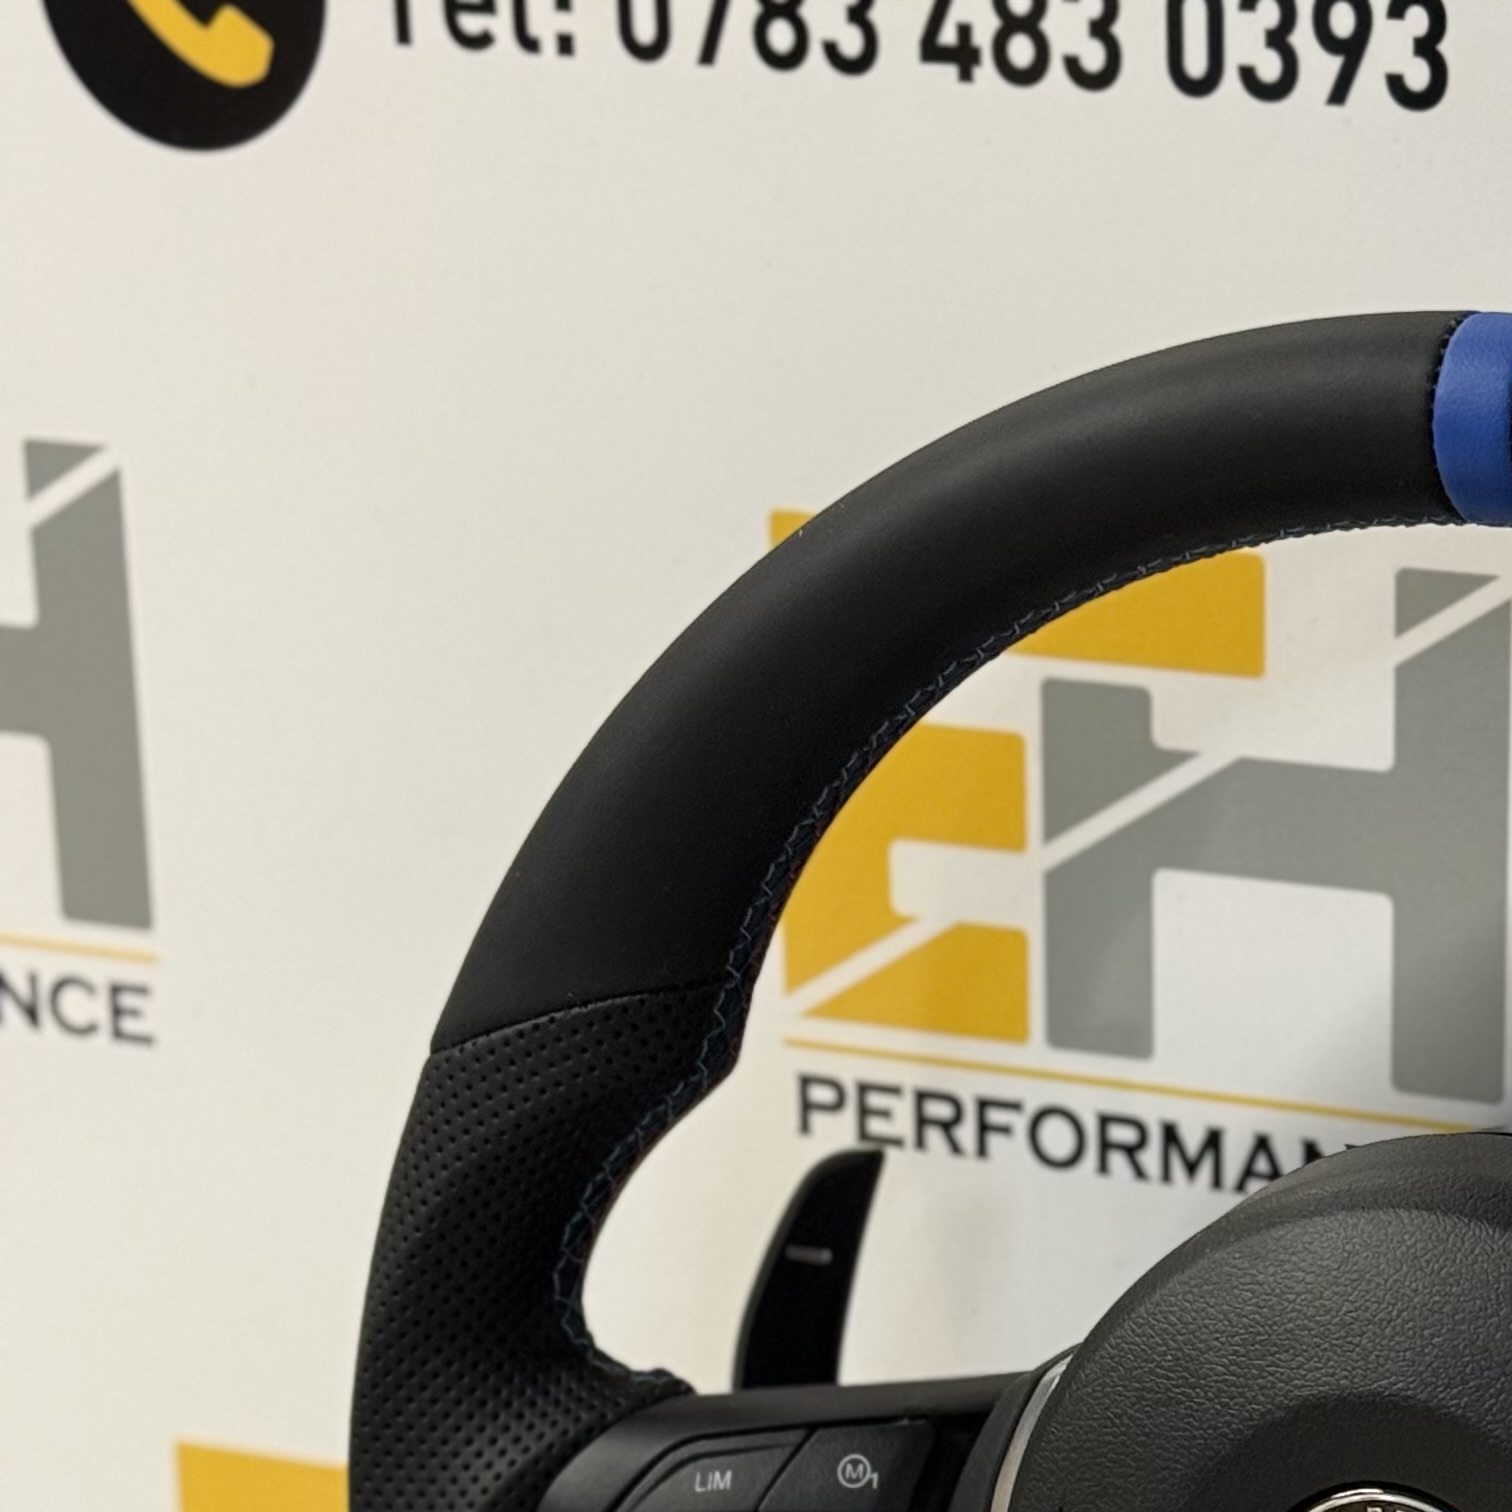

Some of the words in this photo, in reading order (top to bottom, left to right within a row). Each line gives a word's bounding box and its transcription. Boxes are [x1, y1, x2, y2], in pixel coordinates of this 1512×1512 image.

[616, 0, 880, 76] 0783
[918, 0, 1123, 92] 483
[1165, 0, 1449, 112] 0393
[693, 1469, 733, 1493] LIM
